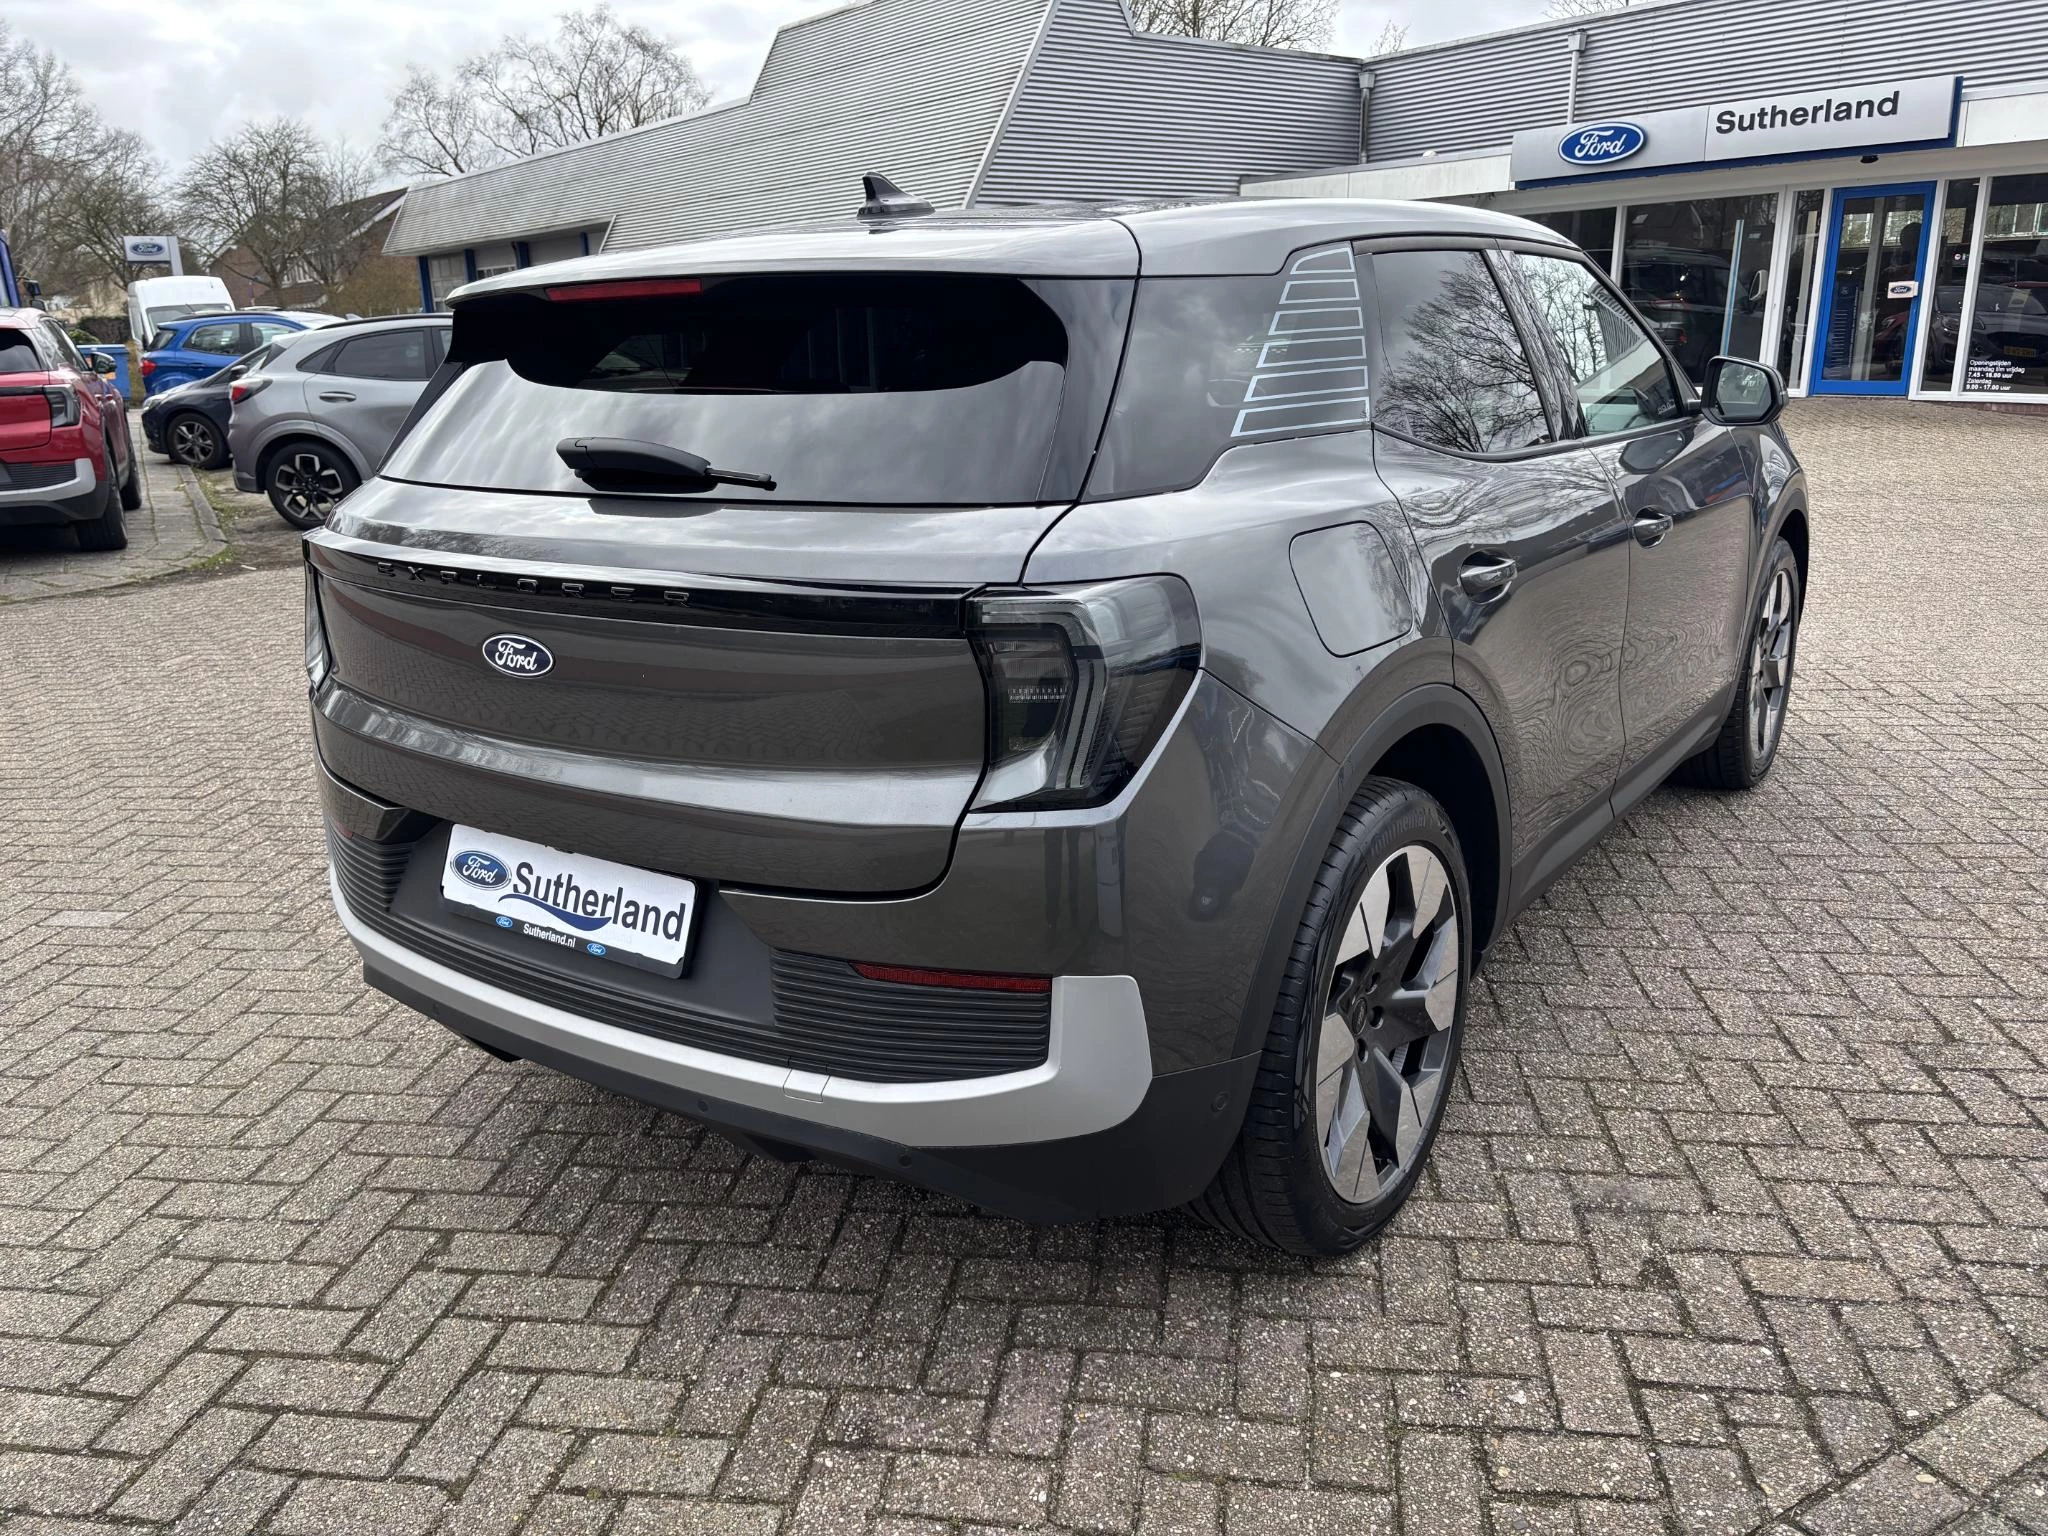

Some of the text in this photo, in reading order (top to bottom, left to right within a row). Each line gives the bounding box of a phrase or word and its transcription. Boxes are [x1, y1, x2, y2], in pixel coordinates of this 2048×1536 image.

[1715, 90, 1900, 135] Sutherland
[1574, 129, 1627, 157] Ford
[377, 561, 691, 608] EXPLORER
[495, 639, 538, 671] Ford
[462, 855, 686, 942] Ford Sutherland
[523, 923, 576, 948] Sutherland.nl
